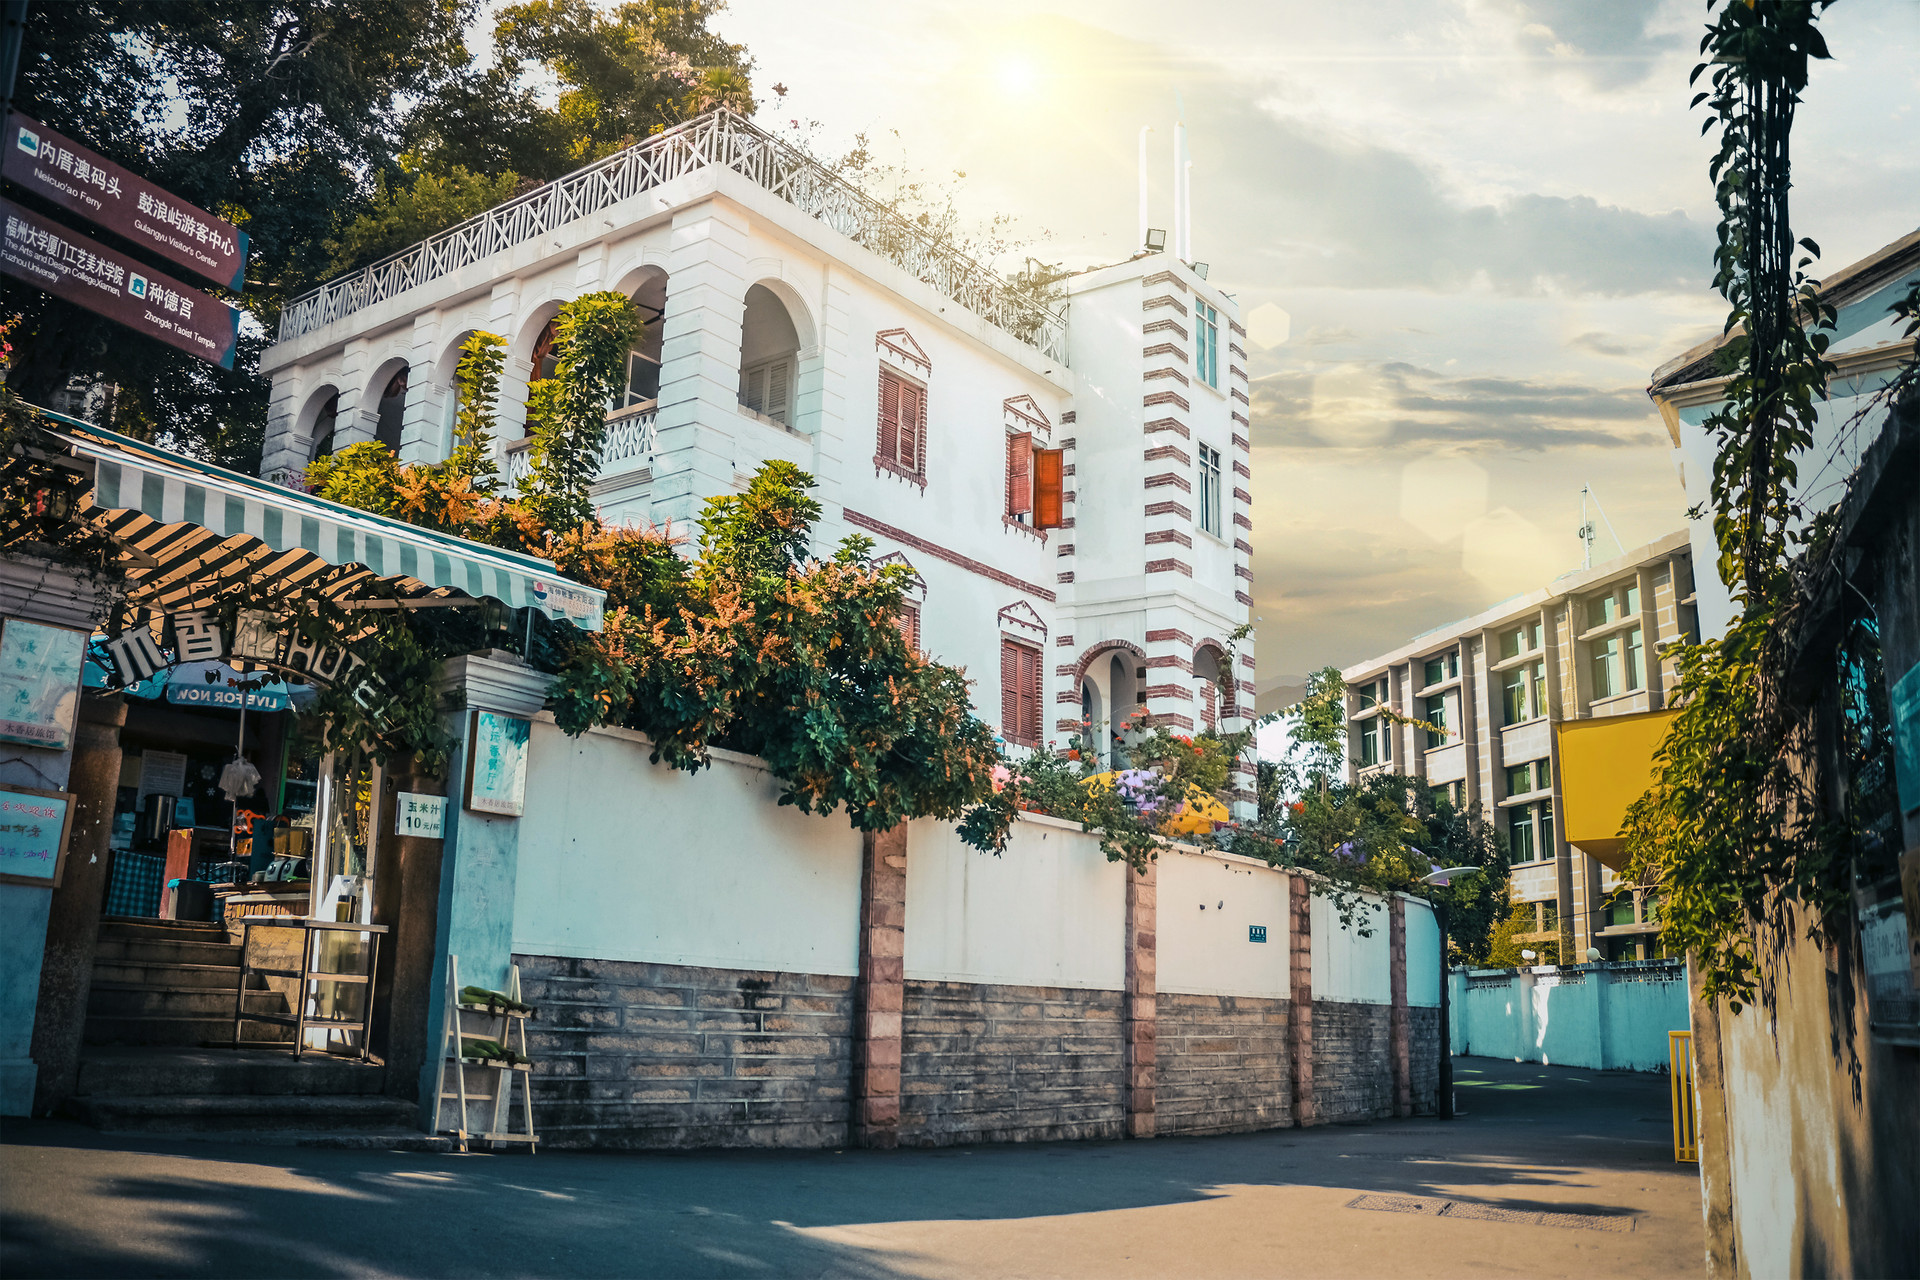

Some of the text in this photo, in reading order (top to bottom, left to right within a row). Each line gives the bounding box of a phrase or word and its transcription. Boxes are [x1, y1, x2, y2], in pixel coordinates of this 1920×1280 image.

[34, 167, 102, 211] Neicuo'ao Ferry
[40, 140, 122, 200] 内厝澳码头
[134, 219, 218, 268] Gulangyu Visitor's Center
[137, 191, 235, 257] 鼓浪屿游客中心
[0, 248, 60, 283] Fuzhou University
[4, 236, 19, 251] The
[18, 244, 34, 257] Arts
[34, 252, 48, 263] and
[47, 257, 72, 275] Design
[6, 215, 125, 287] 福州大学厦门工艺美术学院
[148, 282, 195, 320] 种德宫
[144, 309, 217, 349] Zhongde Taoist Temple
[407, 801, 441, 815] 玉米汁
